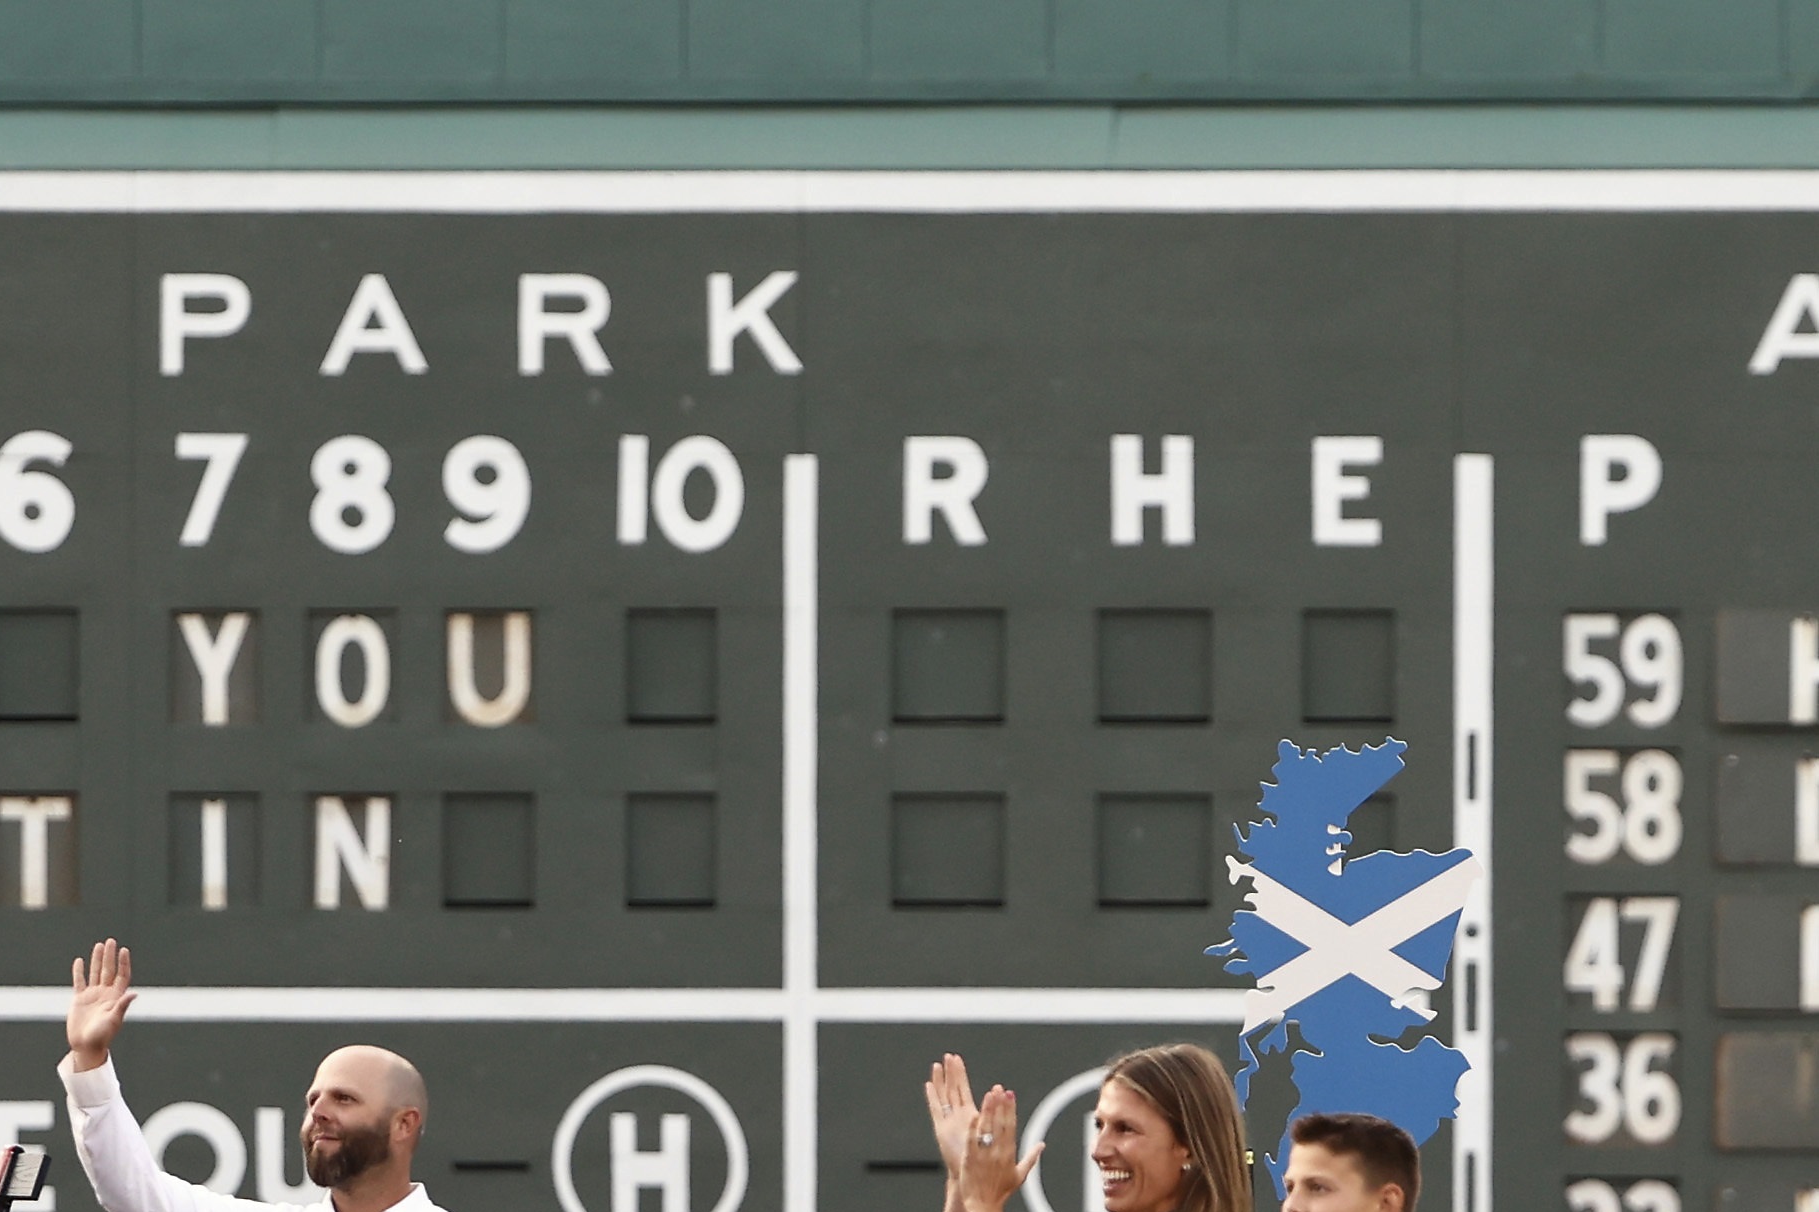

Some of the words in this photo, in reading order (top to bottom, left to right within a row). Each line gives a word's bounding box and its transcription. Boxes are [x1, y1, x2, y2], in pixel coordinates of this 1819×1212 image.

[160, 271, 803, 375] PARK
[176, 433, 247, 546] 7
[310, 435, 394, 553] 8
[443, 436, 531, 552] 9
[618, 435, 744, 552] 10
[904, 436, 988, 545] R
[1111, 435, 1194, 545] H
[1312, 436, 1384, 545] E
[1581, 435, 1662, 545] P
[179, 614, 531, 727] YOU
[1564, 614, 1682, 727] 59
[1565, 750, 1682, 864] 58
[1565, 897, 1679, 1012] 47
[1565, 1033, 1681, 1142] 36
